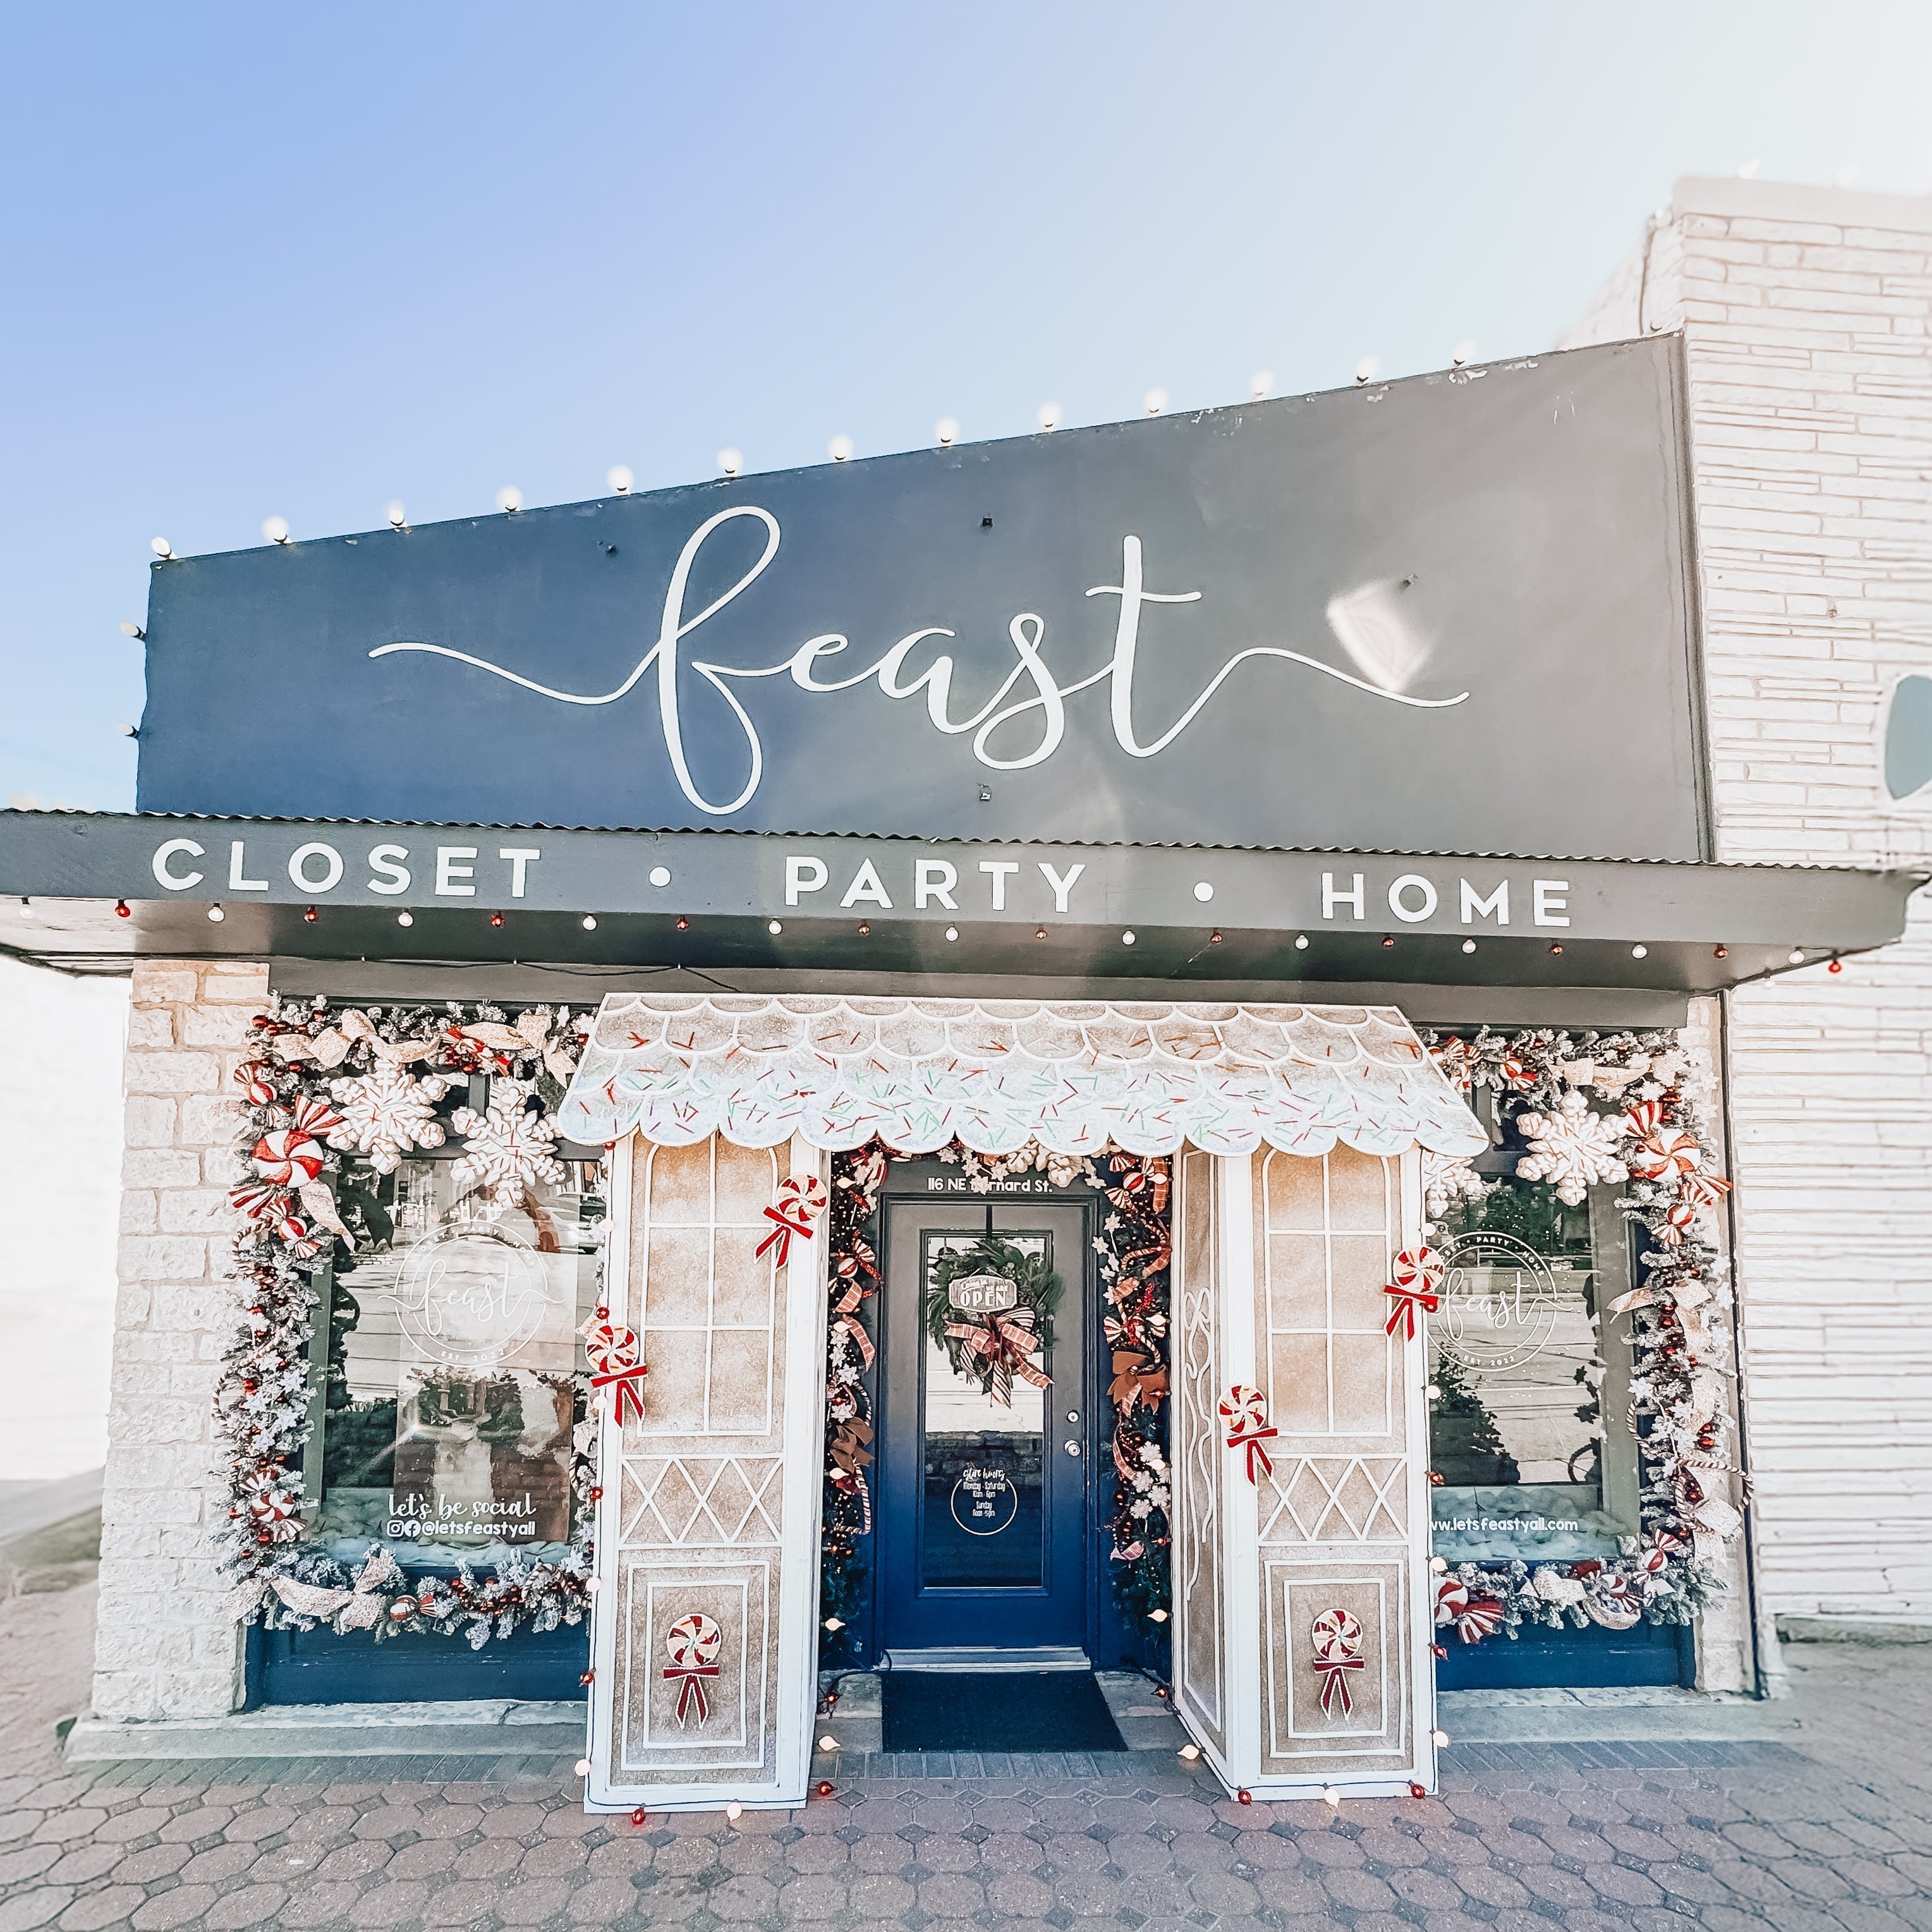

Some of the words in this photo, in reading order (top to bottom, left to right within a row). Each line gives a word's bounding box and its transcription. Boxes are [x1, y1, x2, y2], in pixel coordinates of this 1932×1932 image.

[368, 505, 1470, 815] feast
[152, 838, 540, 897] CLOSET
[785, 856, 1086, 913] PARTY
[1321, 872, 1571, 927] HOME
[928, 1177, 944, 1191] 116
[948, 1178, 966, 1191] NE
[971, 1179, 1031, 1192] rnard
[1035, 1179, 1053, 1193] St.
[411, 1232, 447, 1263] CLOSET
[463, 1225, 500, 1235] PARTY
[513, 1240, 536, 1268] HOME
[1440, 1242, 1461, 1261] OSET
[1476, 1236, 1509, 1246] PARTY
[1522, 1251, 1545, 1277] HOME
[377, 1258, 566, 1336] feast
[961, 1291, 1005, 1306] OPEN
[1428, 1267, 1574, 1341] feast
[441, 1351, 463, 1361] EST.
[472, 1349, 505, 1362] 2022
[1490, 1356, 1515, 1366] 2022
[985, 1481, 1005, 1492] Saturday
[389, 1493, 432, 1520] let's
[439, 1493, 468, 1520] be
[471, 1492, 537, 1518] social
[976, 1501, 992, 1511] Sunday
[422, 1520, 536, 1538] @letsfeastyall
